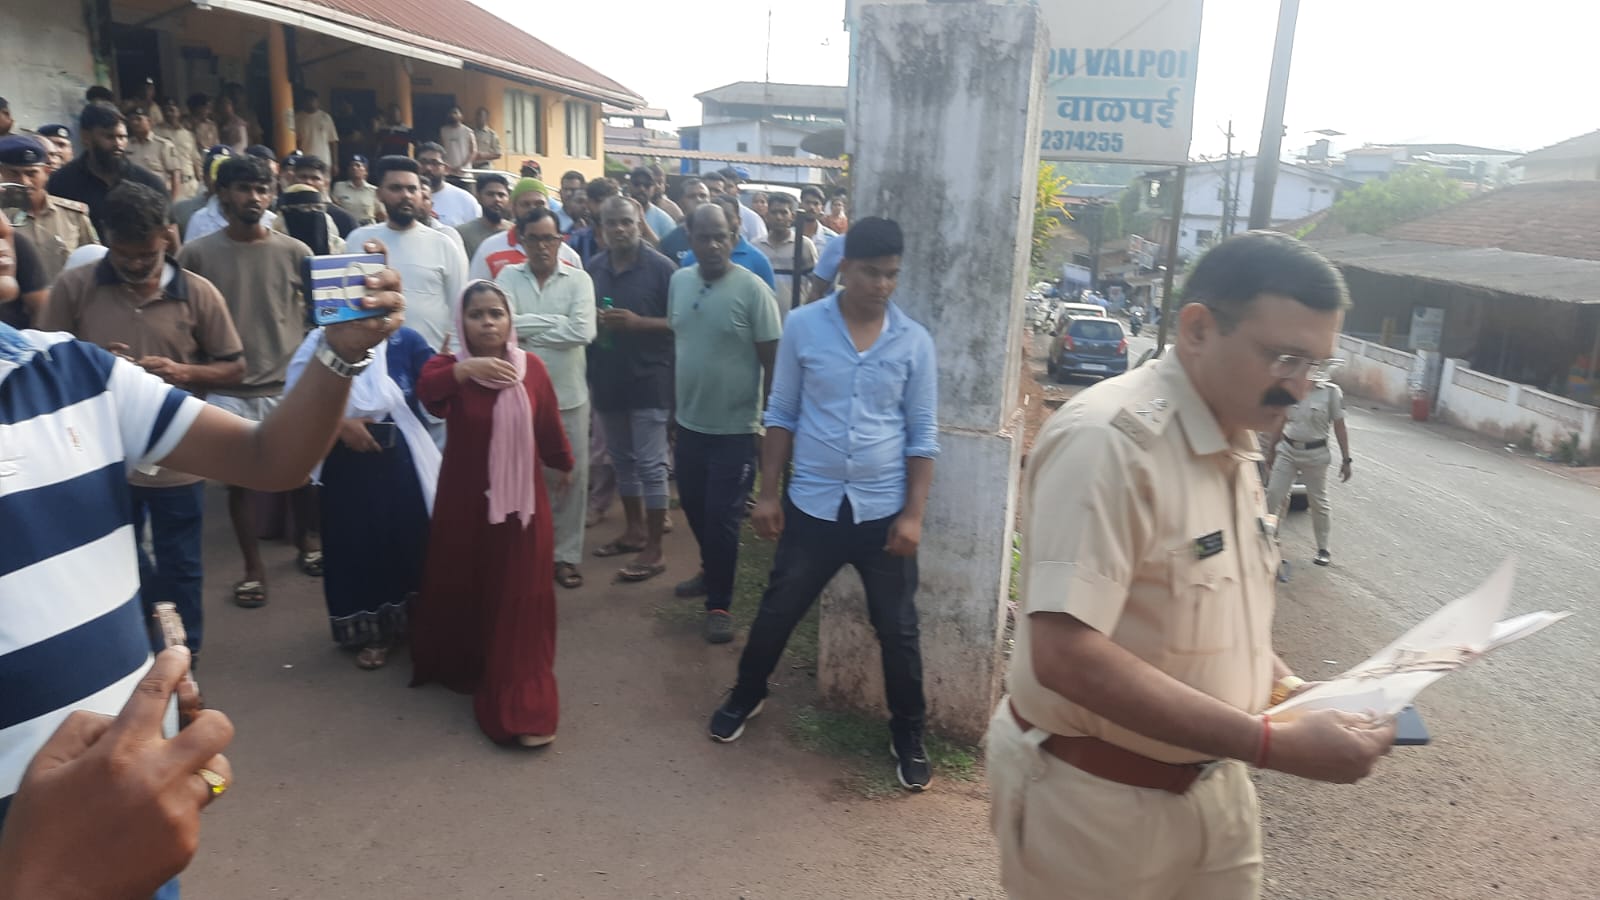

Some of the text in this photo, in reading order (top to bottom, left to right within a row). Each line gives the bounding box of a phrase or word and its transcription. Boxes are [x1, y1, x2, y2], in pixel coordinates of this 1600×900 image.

[1086, 49, 1187, 78] VALPOI
[1057, 88, 1180, 128] वाळपई
[1041, 130, 1124, 152] 2374255
